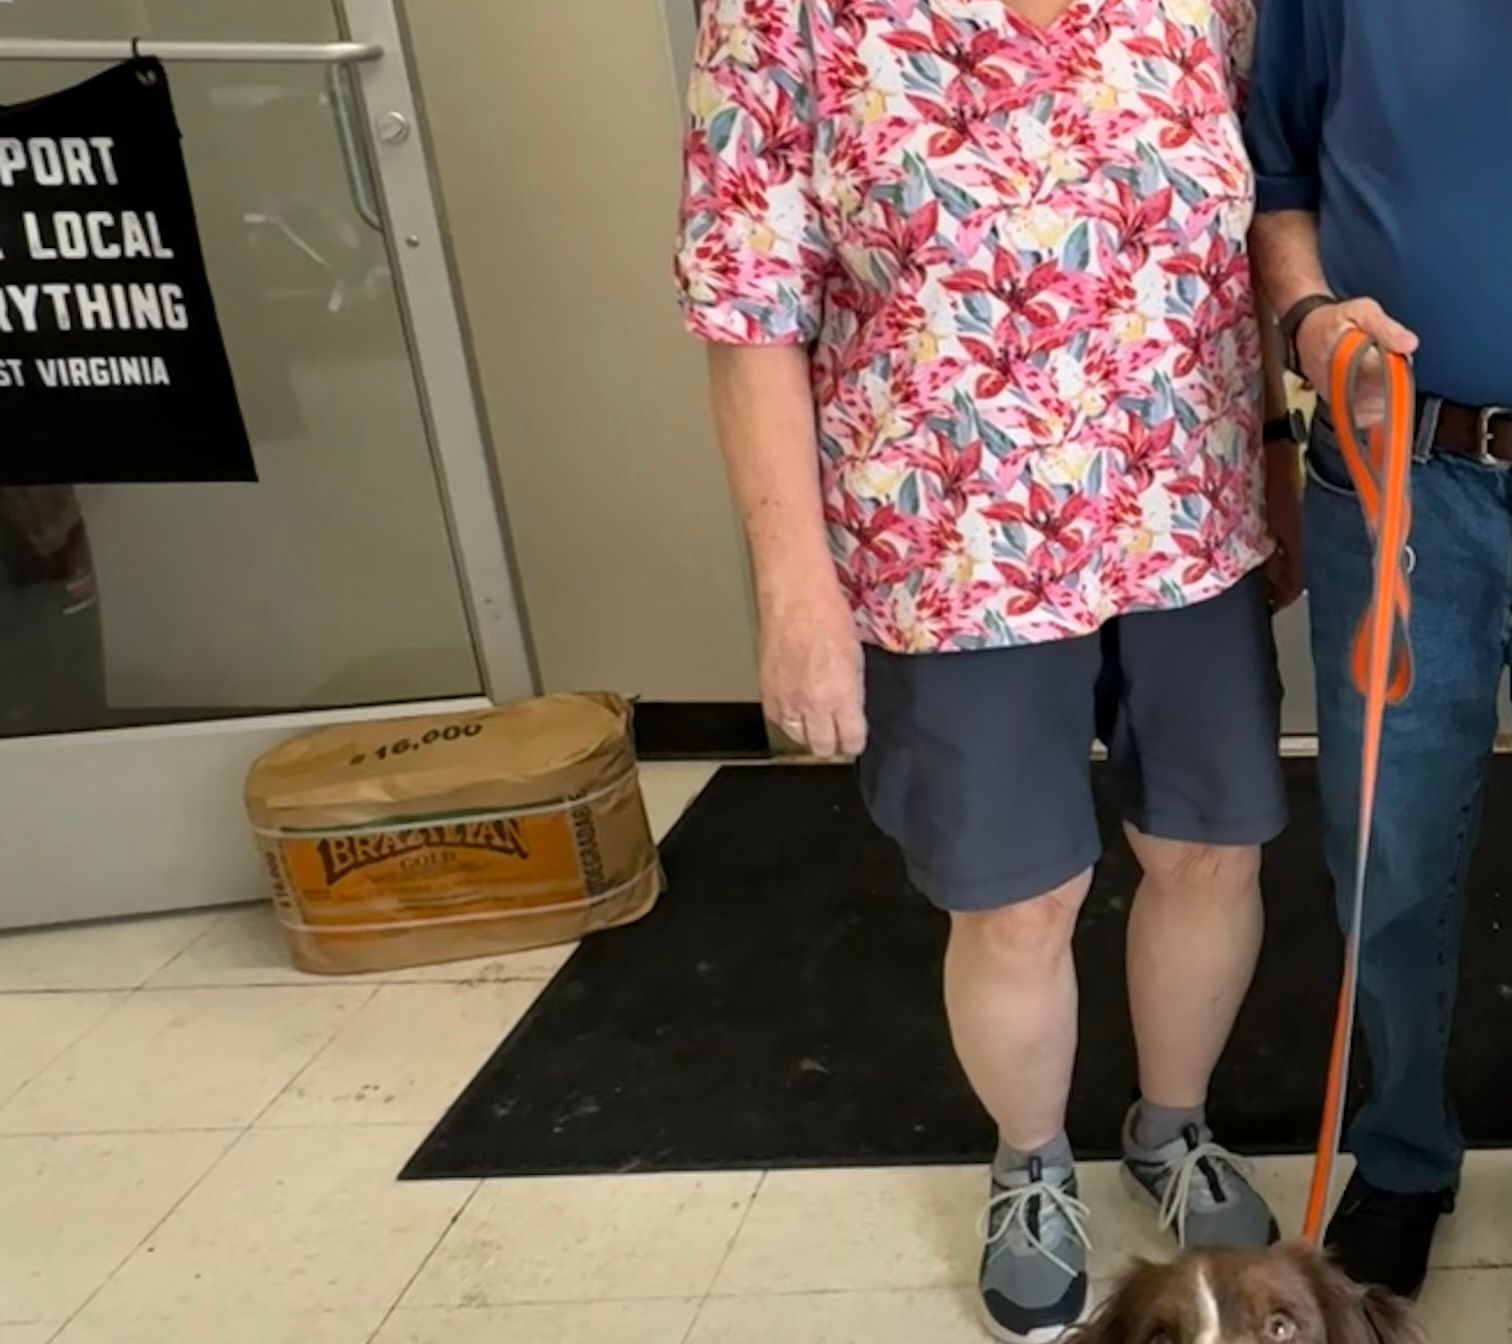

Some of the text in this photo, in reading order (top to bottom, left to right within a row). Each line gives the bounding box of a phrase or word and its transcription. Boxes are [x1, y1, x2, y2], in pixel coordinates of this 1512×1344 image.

[23, 211, 173, 260] LOCAL
[36, 356, 170, 387] VIRGINIA
[374, 723, 483, 759] 16,000
